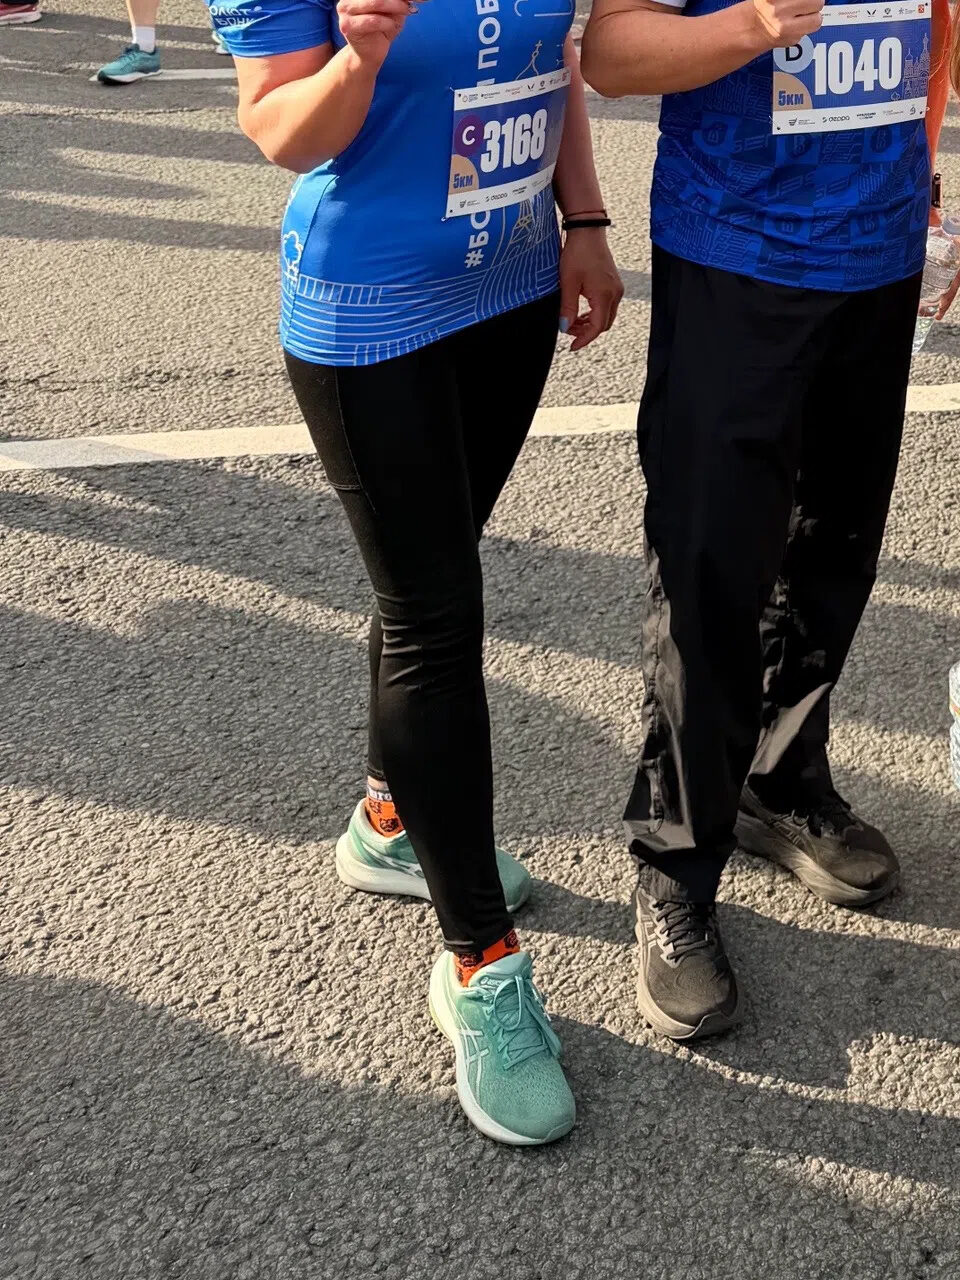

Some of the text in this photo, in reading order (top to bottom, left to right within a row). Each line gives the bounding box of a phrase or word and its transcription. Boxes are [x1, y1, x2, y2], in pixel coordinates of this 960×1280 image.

[812, 37, 902, 96] 1040
[462, 125, 476, 146] C
[480, 108, 548, 173] 3168
